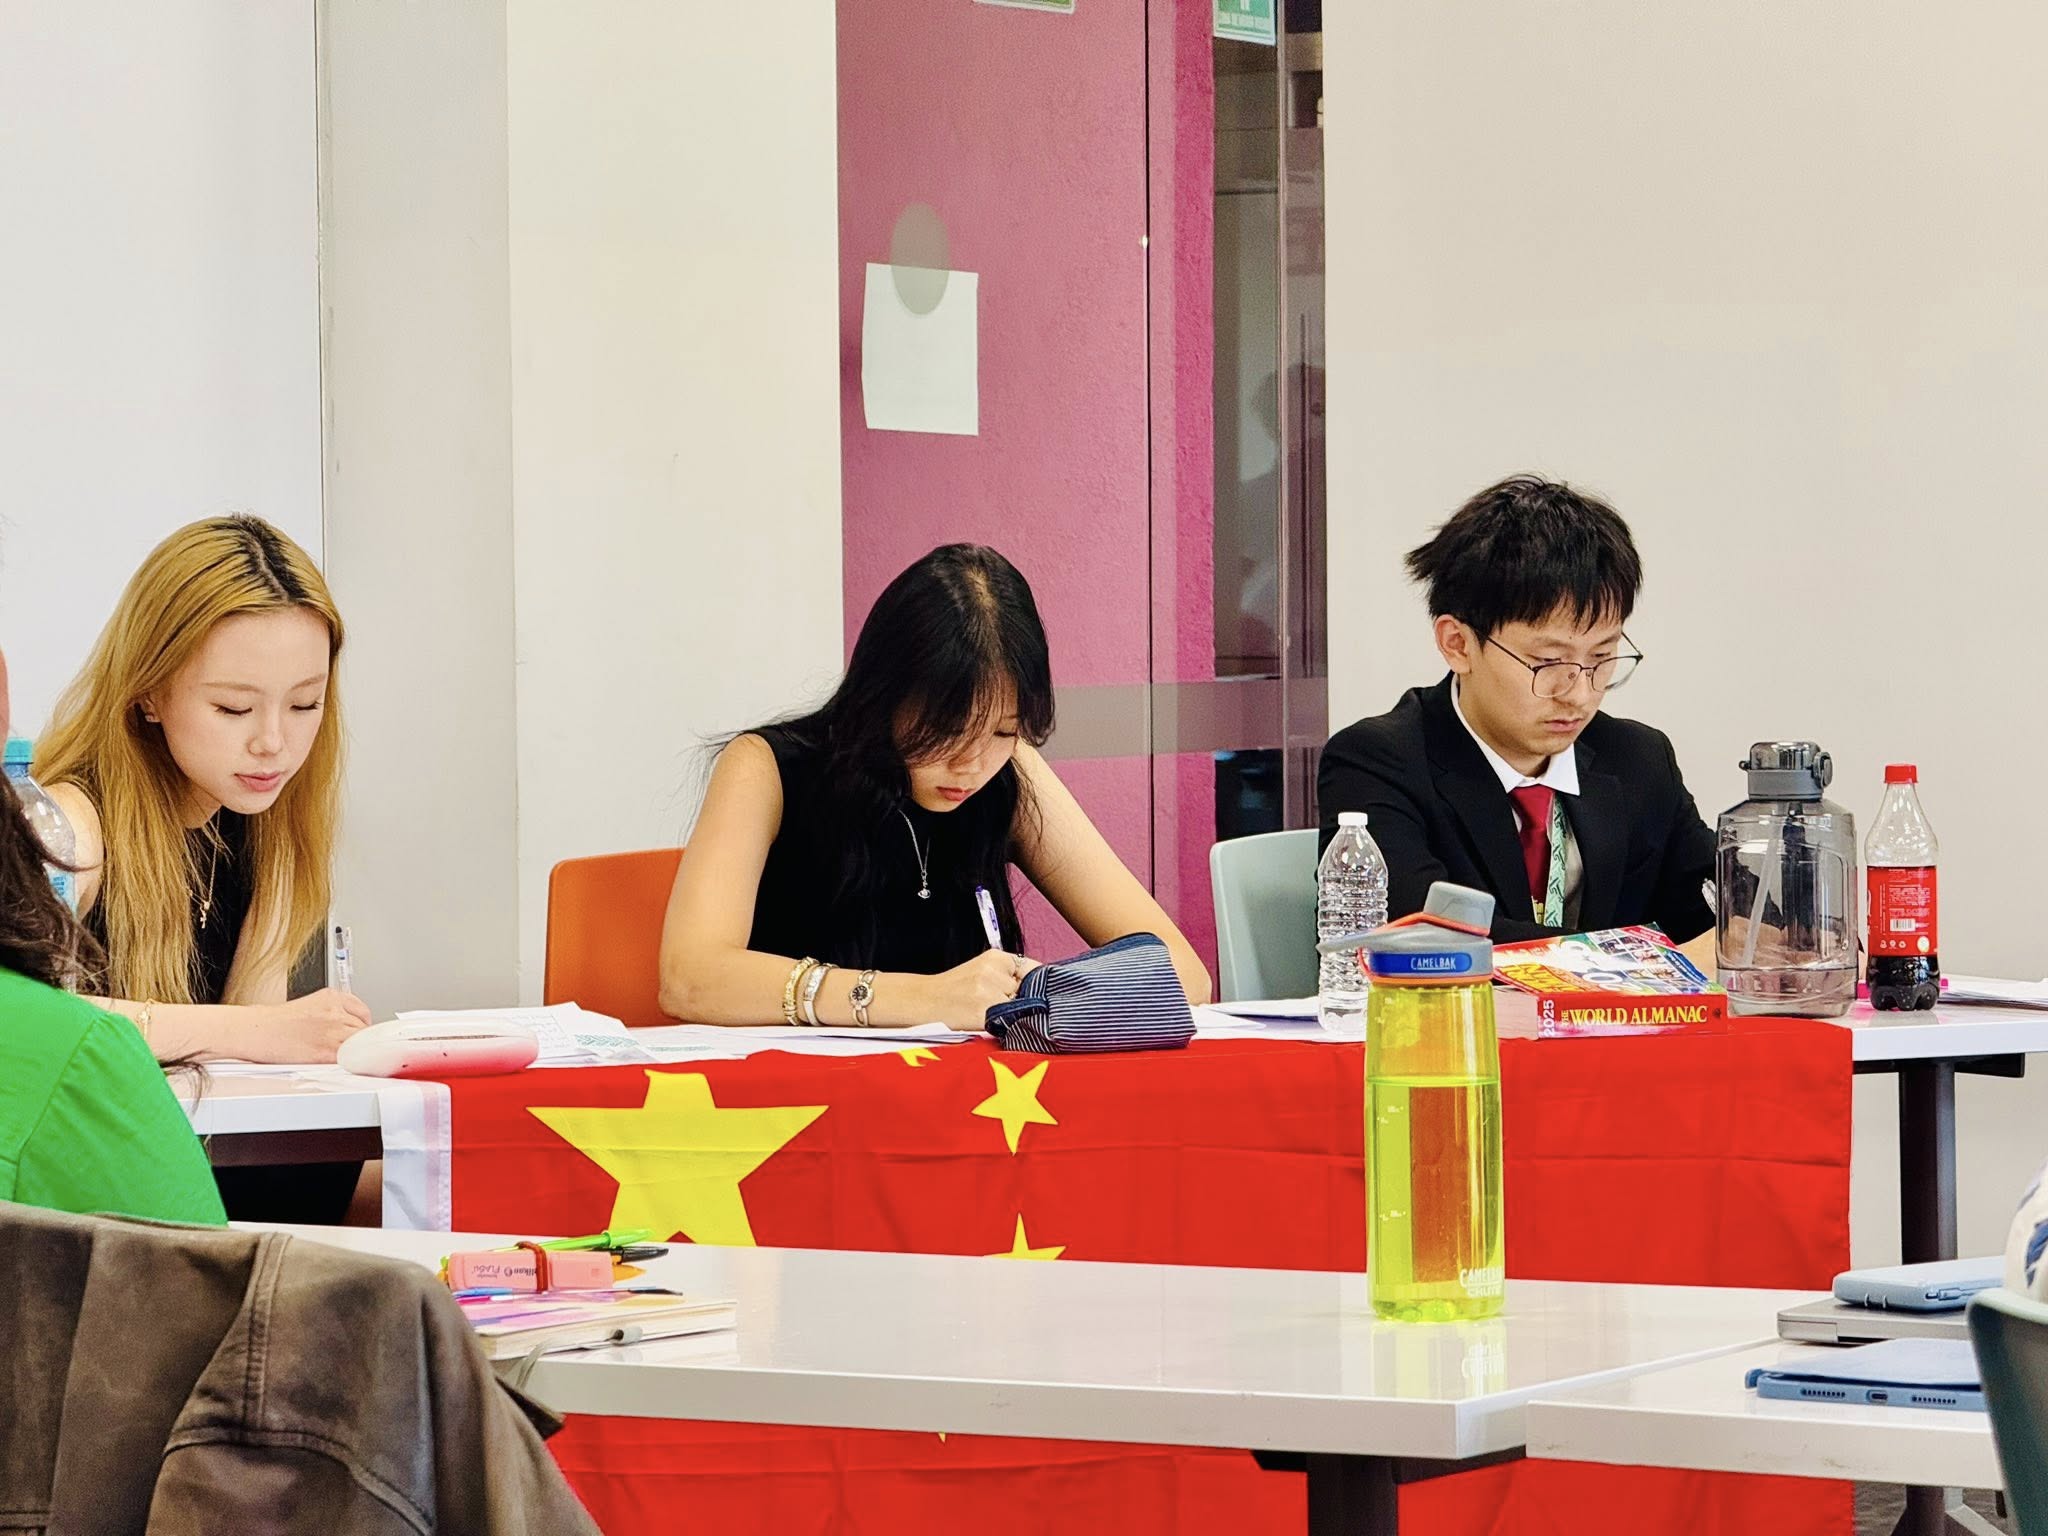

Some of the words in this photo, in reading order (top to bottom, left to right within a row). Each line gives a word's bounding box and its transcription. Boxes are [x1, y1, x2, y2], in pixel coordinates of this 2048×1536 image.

[1411, 957, 1456, 970] CAMELBAK
[1542, 1000, 1555, 1036] 2025
[1569, 1008, 1628, 1026] WORLD
[1630, 1005, 1707, 1025] ALMANAC
[514, 1267, 537, 1276] likan
